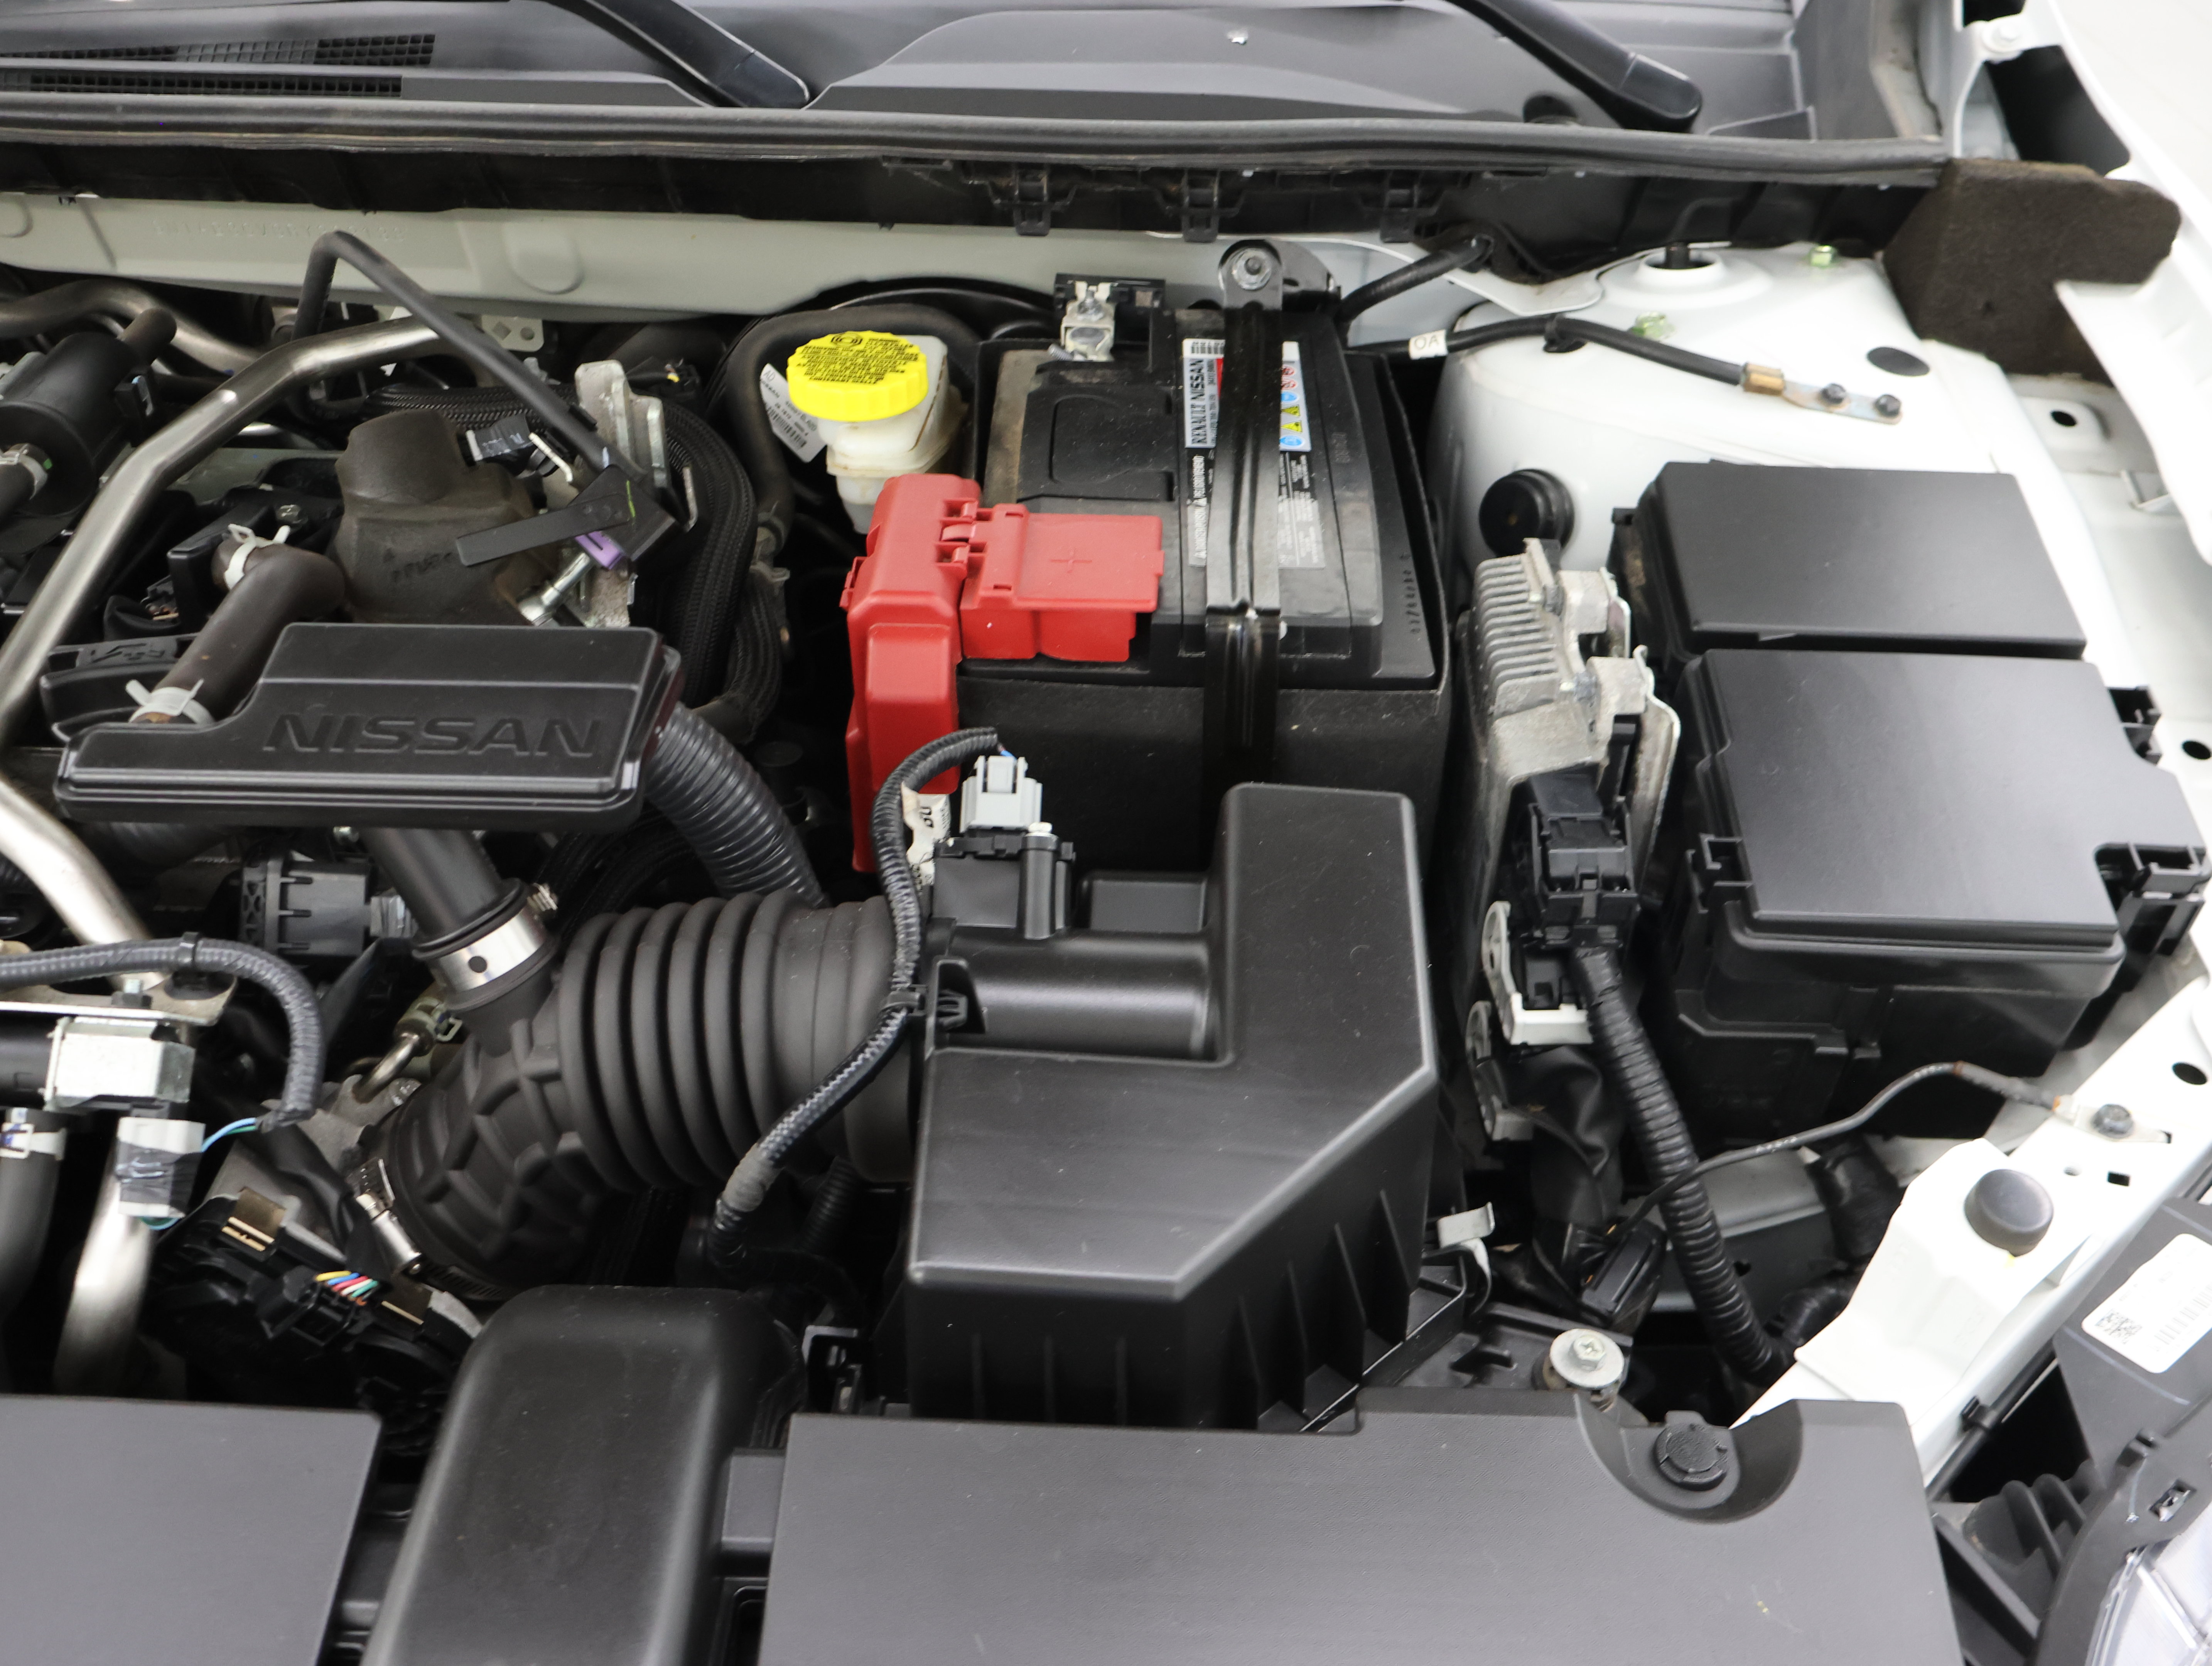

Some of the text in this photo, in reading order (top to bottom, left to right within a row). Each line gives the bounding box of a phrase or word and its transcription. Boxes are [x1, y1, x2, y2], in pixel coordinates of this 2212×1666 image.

[1190, 359, 1207, 444] RENAULT NISSAN
[262, 713, 601, 757] NISSAN
